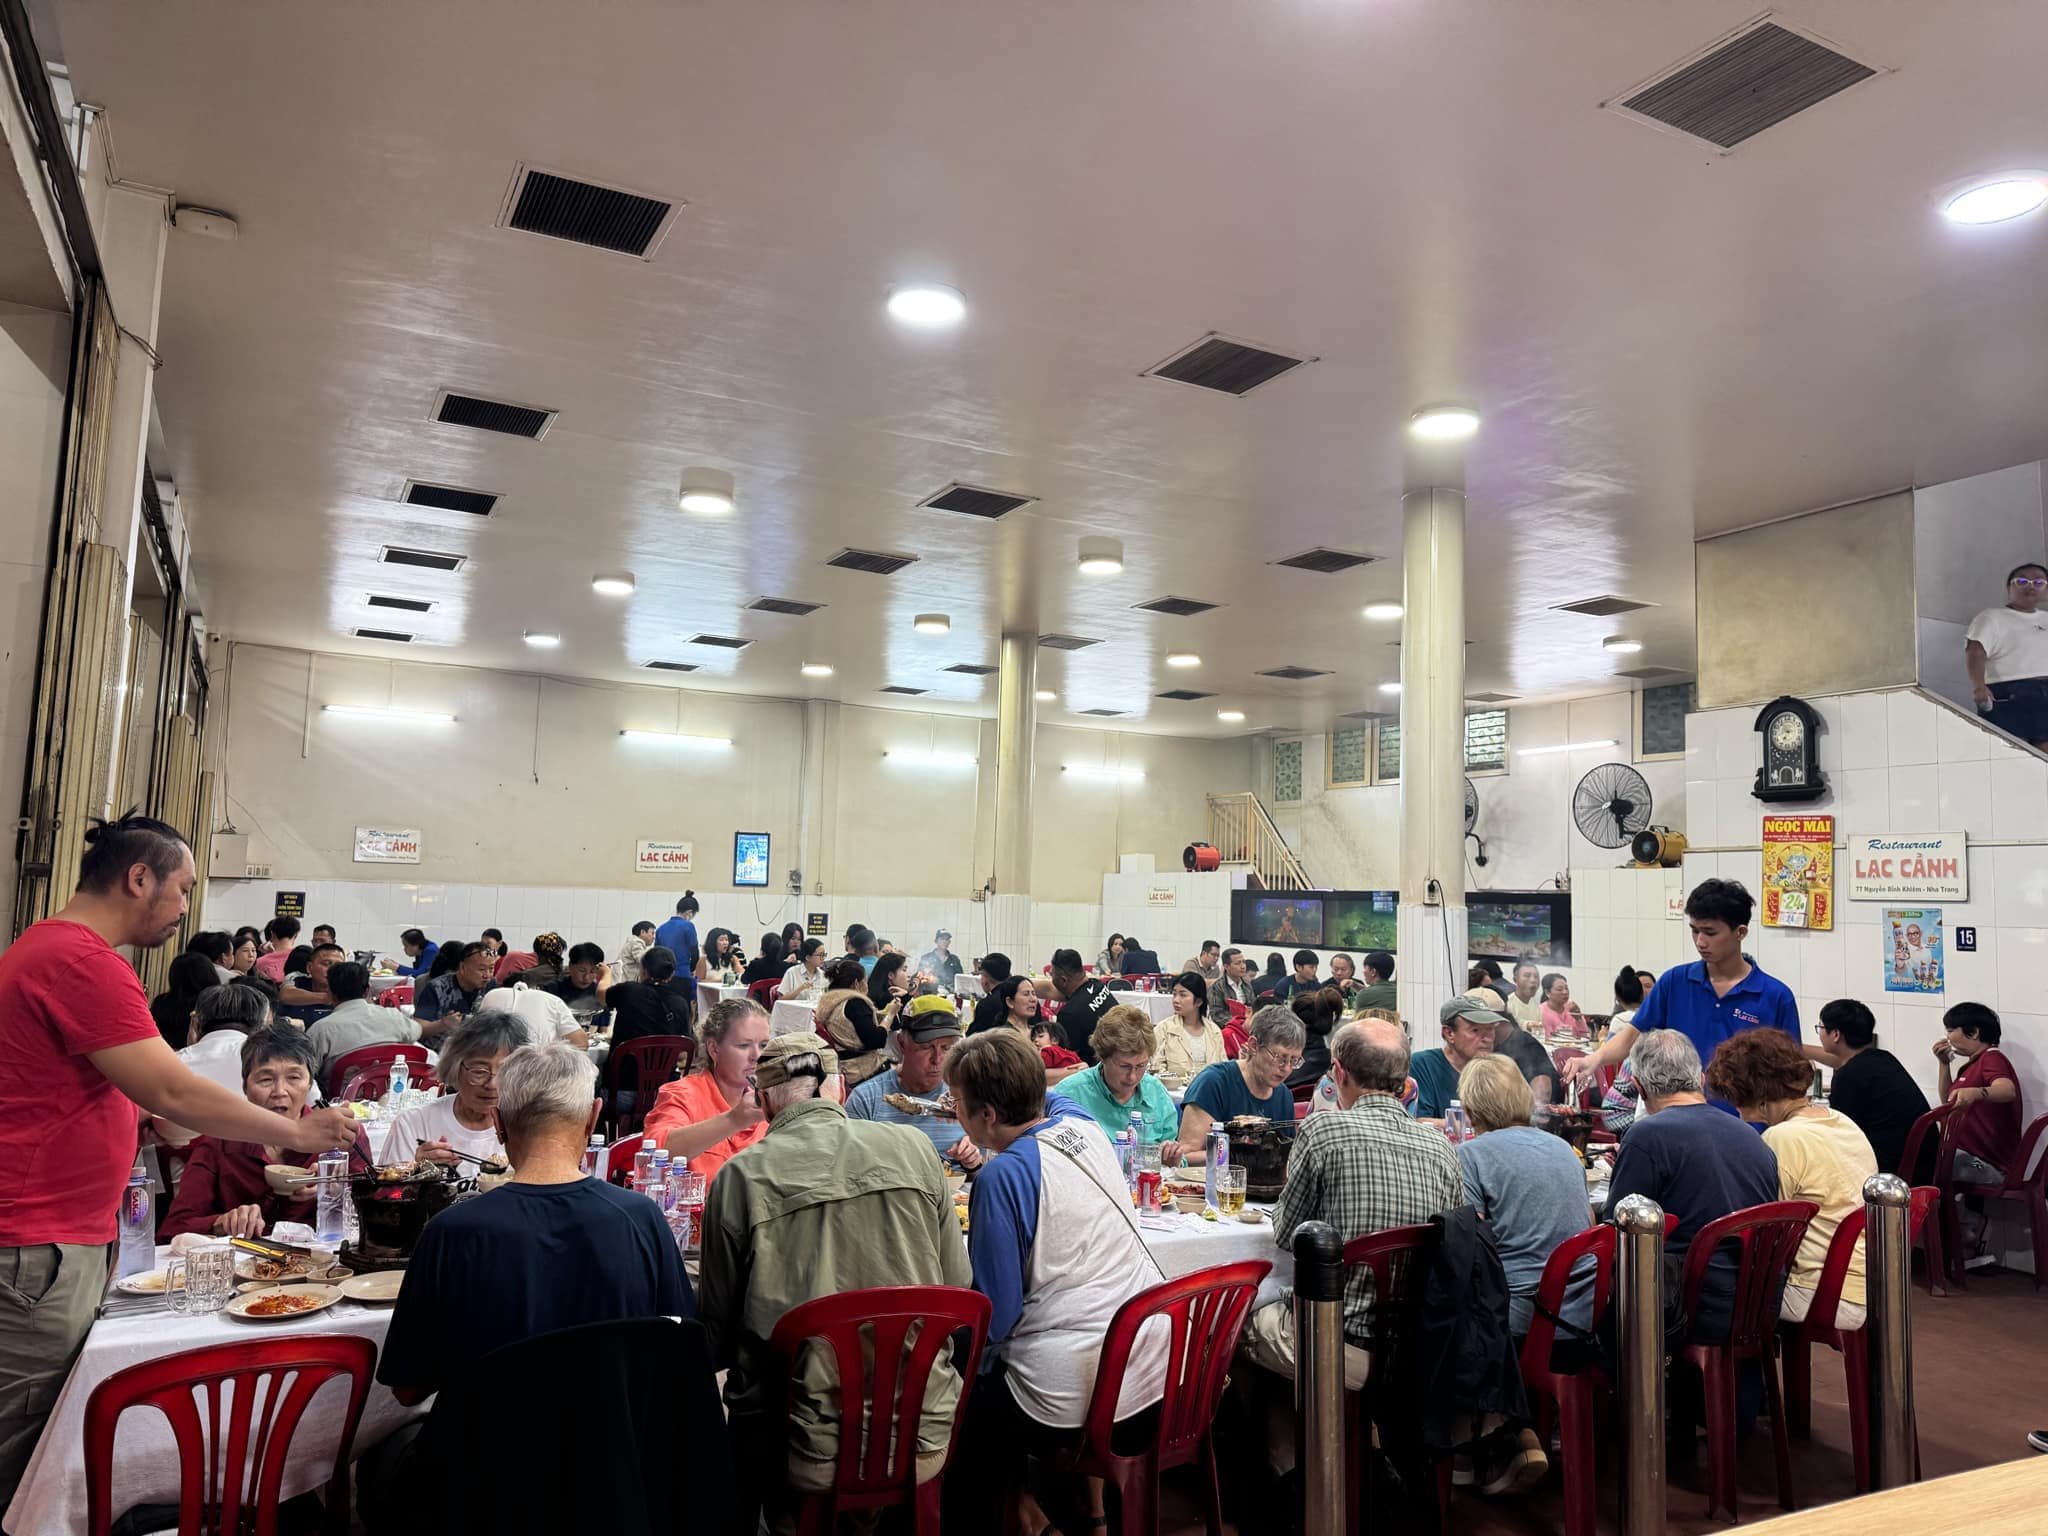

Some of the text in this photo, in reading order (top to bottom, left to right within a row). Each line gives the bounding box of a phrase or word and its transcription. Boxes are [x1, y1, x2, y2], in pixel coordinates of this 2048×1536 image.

[1764, 820, 1831, 835] NGỌC MAI
[1867, 839, 1942, 850] Restaurant
[1855, 853, 1957, 879] LẠC CẢNH
[1940, 886, 1959, 894] Trang
[1785, 893, 1803, 910] 24
[1959, 929, 1974, 945] 15
